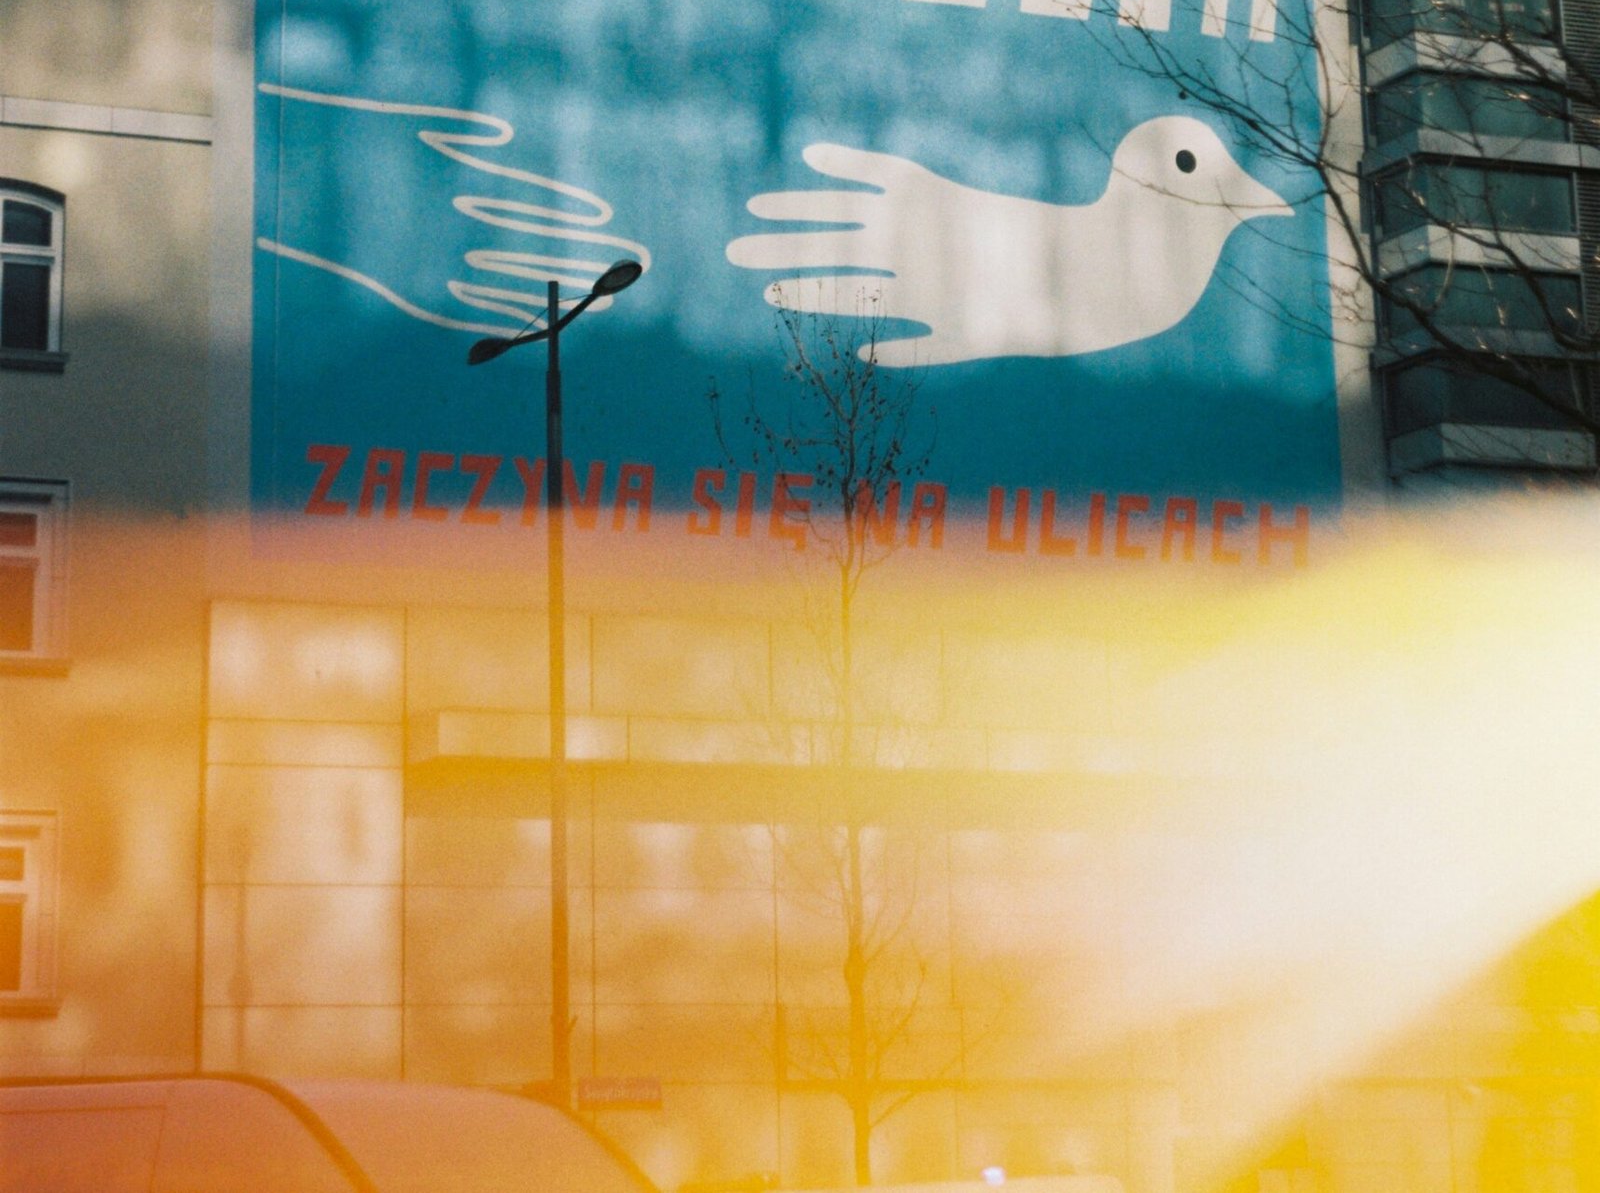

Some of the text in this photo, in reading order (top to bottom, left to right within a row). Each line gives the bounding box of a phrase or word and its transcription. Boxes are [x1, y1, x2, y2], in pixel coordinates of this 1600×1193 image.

[305, 444, 1311, 567] ZACZYNA SIĘ NA ULICACH
